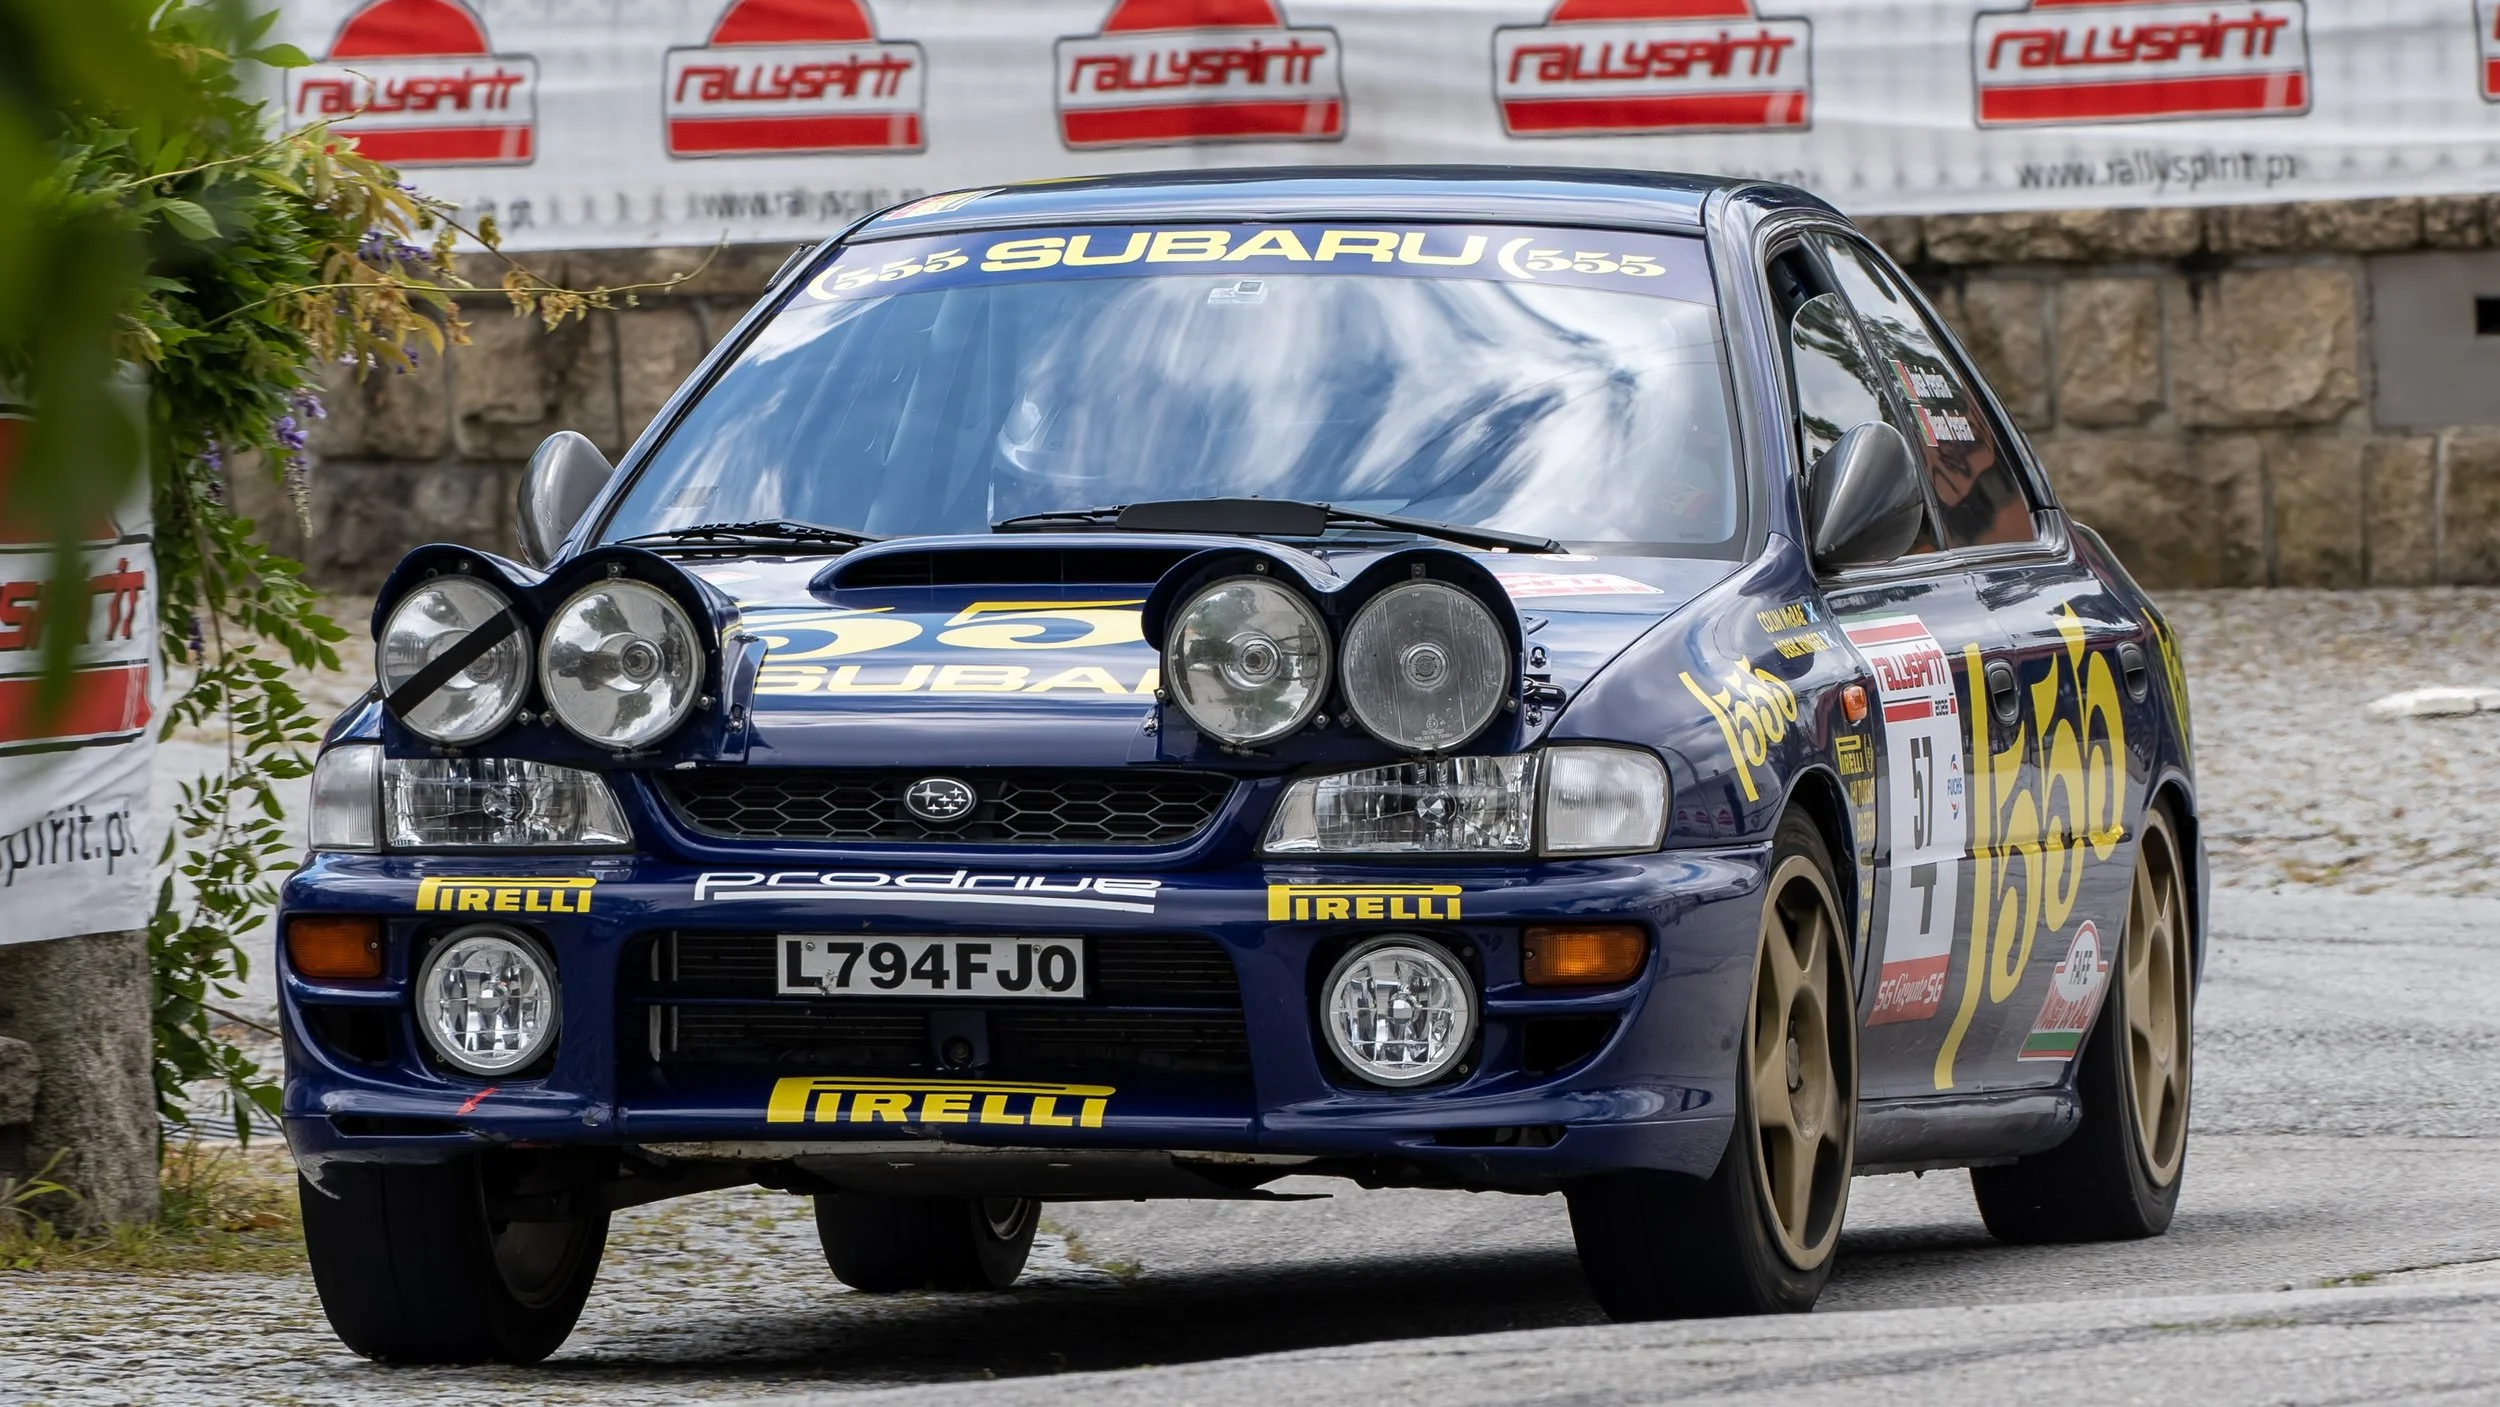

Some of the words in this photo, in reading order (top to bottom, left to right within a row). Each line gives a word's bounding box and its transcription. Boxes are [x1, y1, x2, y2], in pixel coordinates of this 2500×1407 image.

[980, 229, 1489, 272] SUBARU
[1835, 735, 1864, 775] PIRELLI
[1910, 736, 1933, 851] 57
[1948, 777, 1962, 796] FUCHS
[415, 876, 598, 913] PIRELLI
[695, 869, 1161, 914] prodrive
[1267, 884, 1463, 922] PIRELLI
[766, 1075, 1117, 1129] PIRELLI
